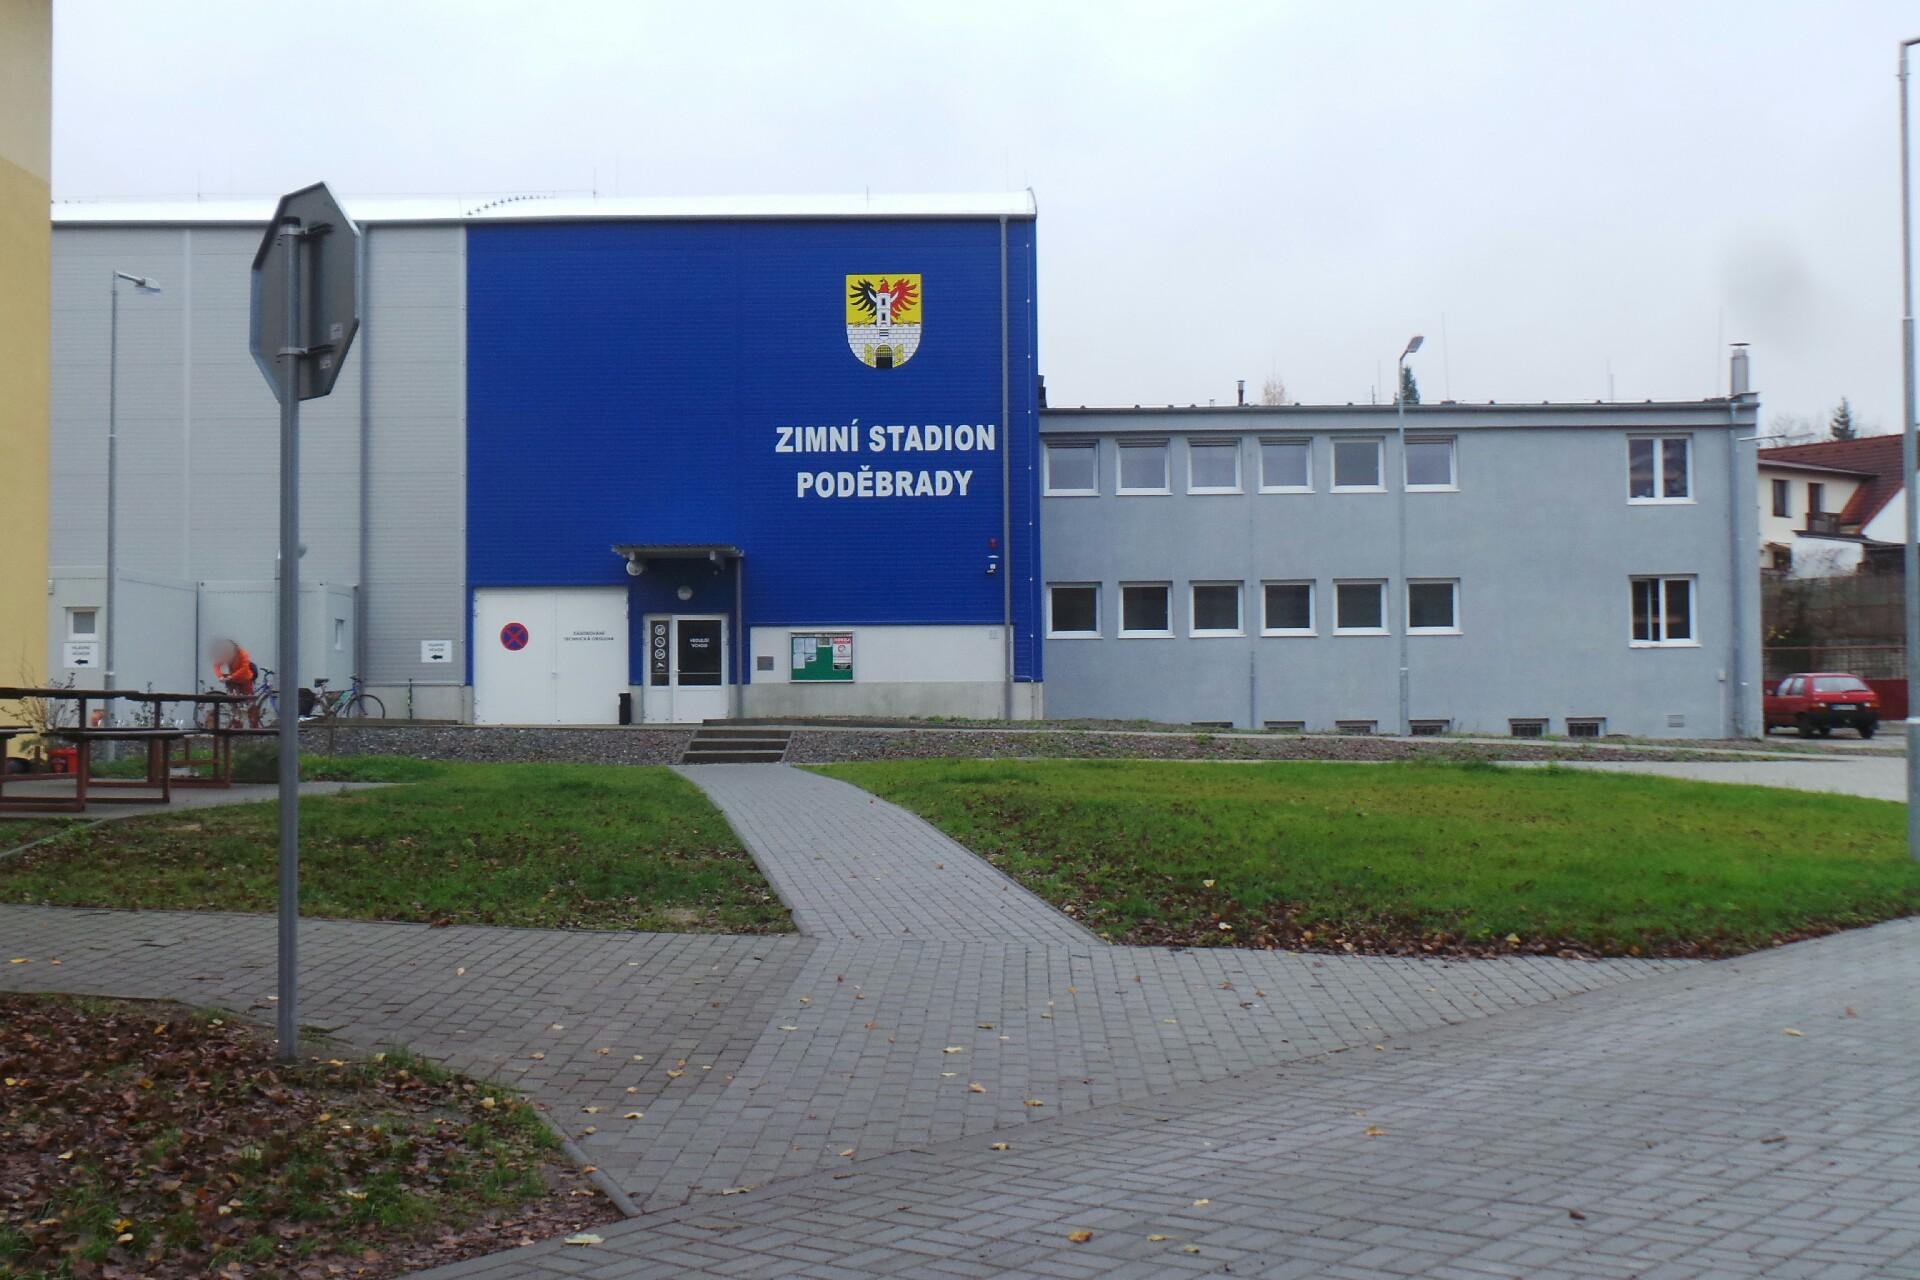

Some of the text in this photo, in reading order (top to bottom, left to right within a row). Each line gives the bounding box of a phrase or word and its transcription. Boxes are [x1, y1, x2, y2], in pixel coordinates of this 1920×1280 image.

[775, 418, 996, 453] ZIMNÍ STADION
[797, 465, 973, 498] PODĚBRADY
